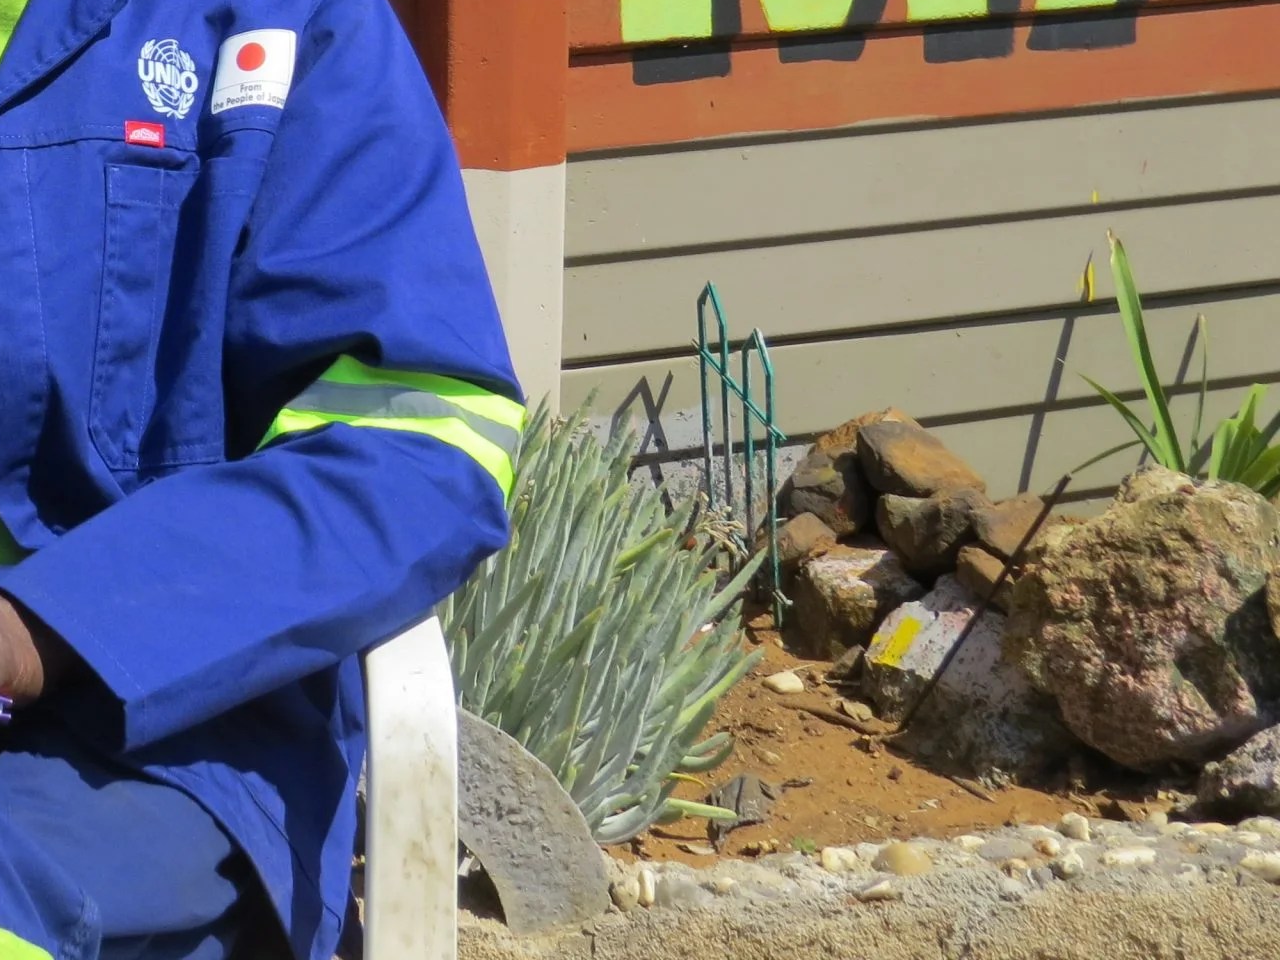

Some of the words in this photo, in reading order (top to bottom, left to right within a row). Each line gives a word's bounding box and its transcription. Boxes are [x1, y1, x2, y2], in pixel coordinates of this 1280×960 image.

[239, 83, 262, 94] From
[213, 101, 224, 112] the
[225, 92, 254, 107] People
[256, 91, 265, 101] of
